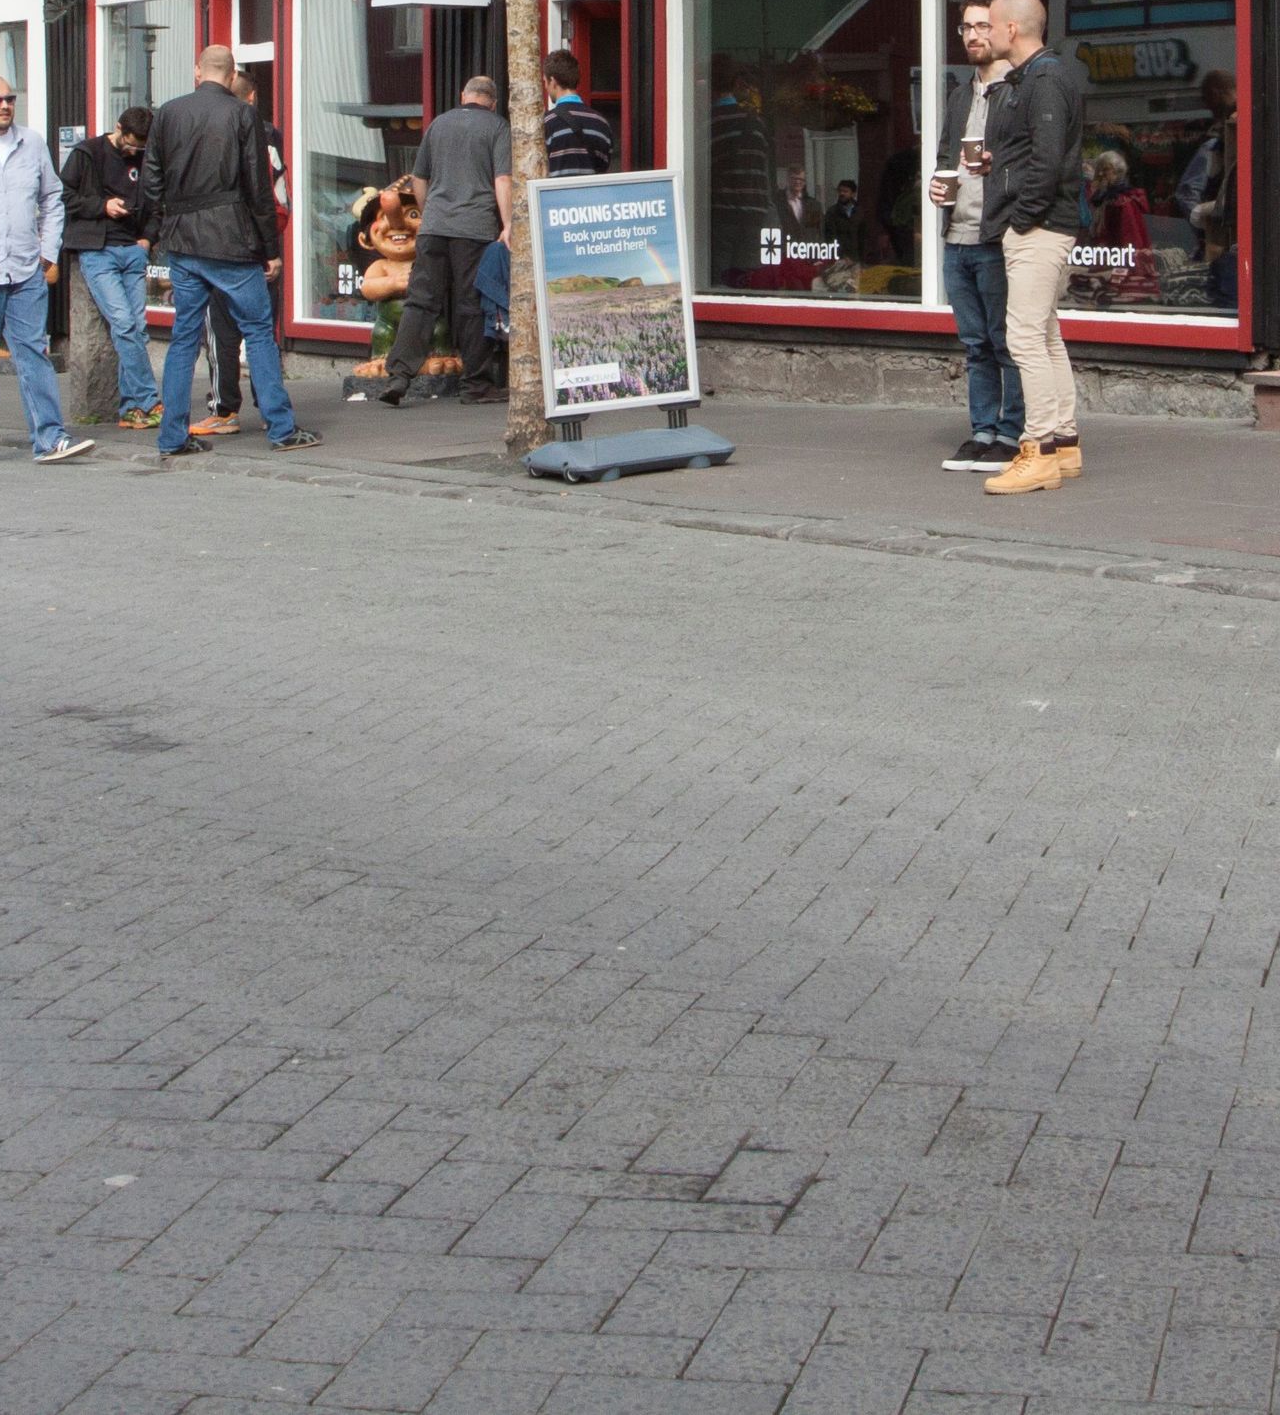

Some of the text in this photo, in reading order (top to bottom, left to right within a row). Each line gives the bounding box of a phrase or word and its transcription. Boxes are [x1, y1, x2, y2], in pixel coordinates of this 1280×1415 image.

[549, 199, 666, 227] BOOKING SERVICE
[563, 224, 658, 243] Book your day tours
[576, 238, 648, 256] in Iceland here!
[786, 234, 840, 260] icemart
